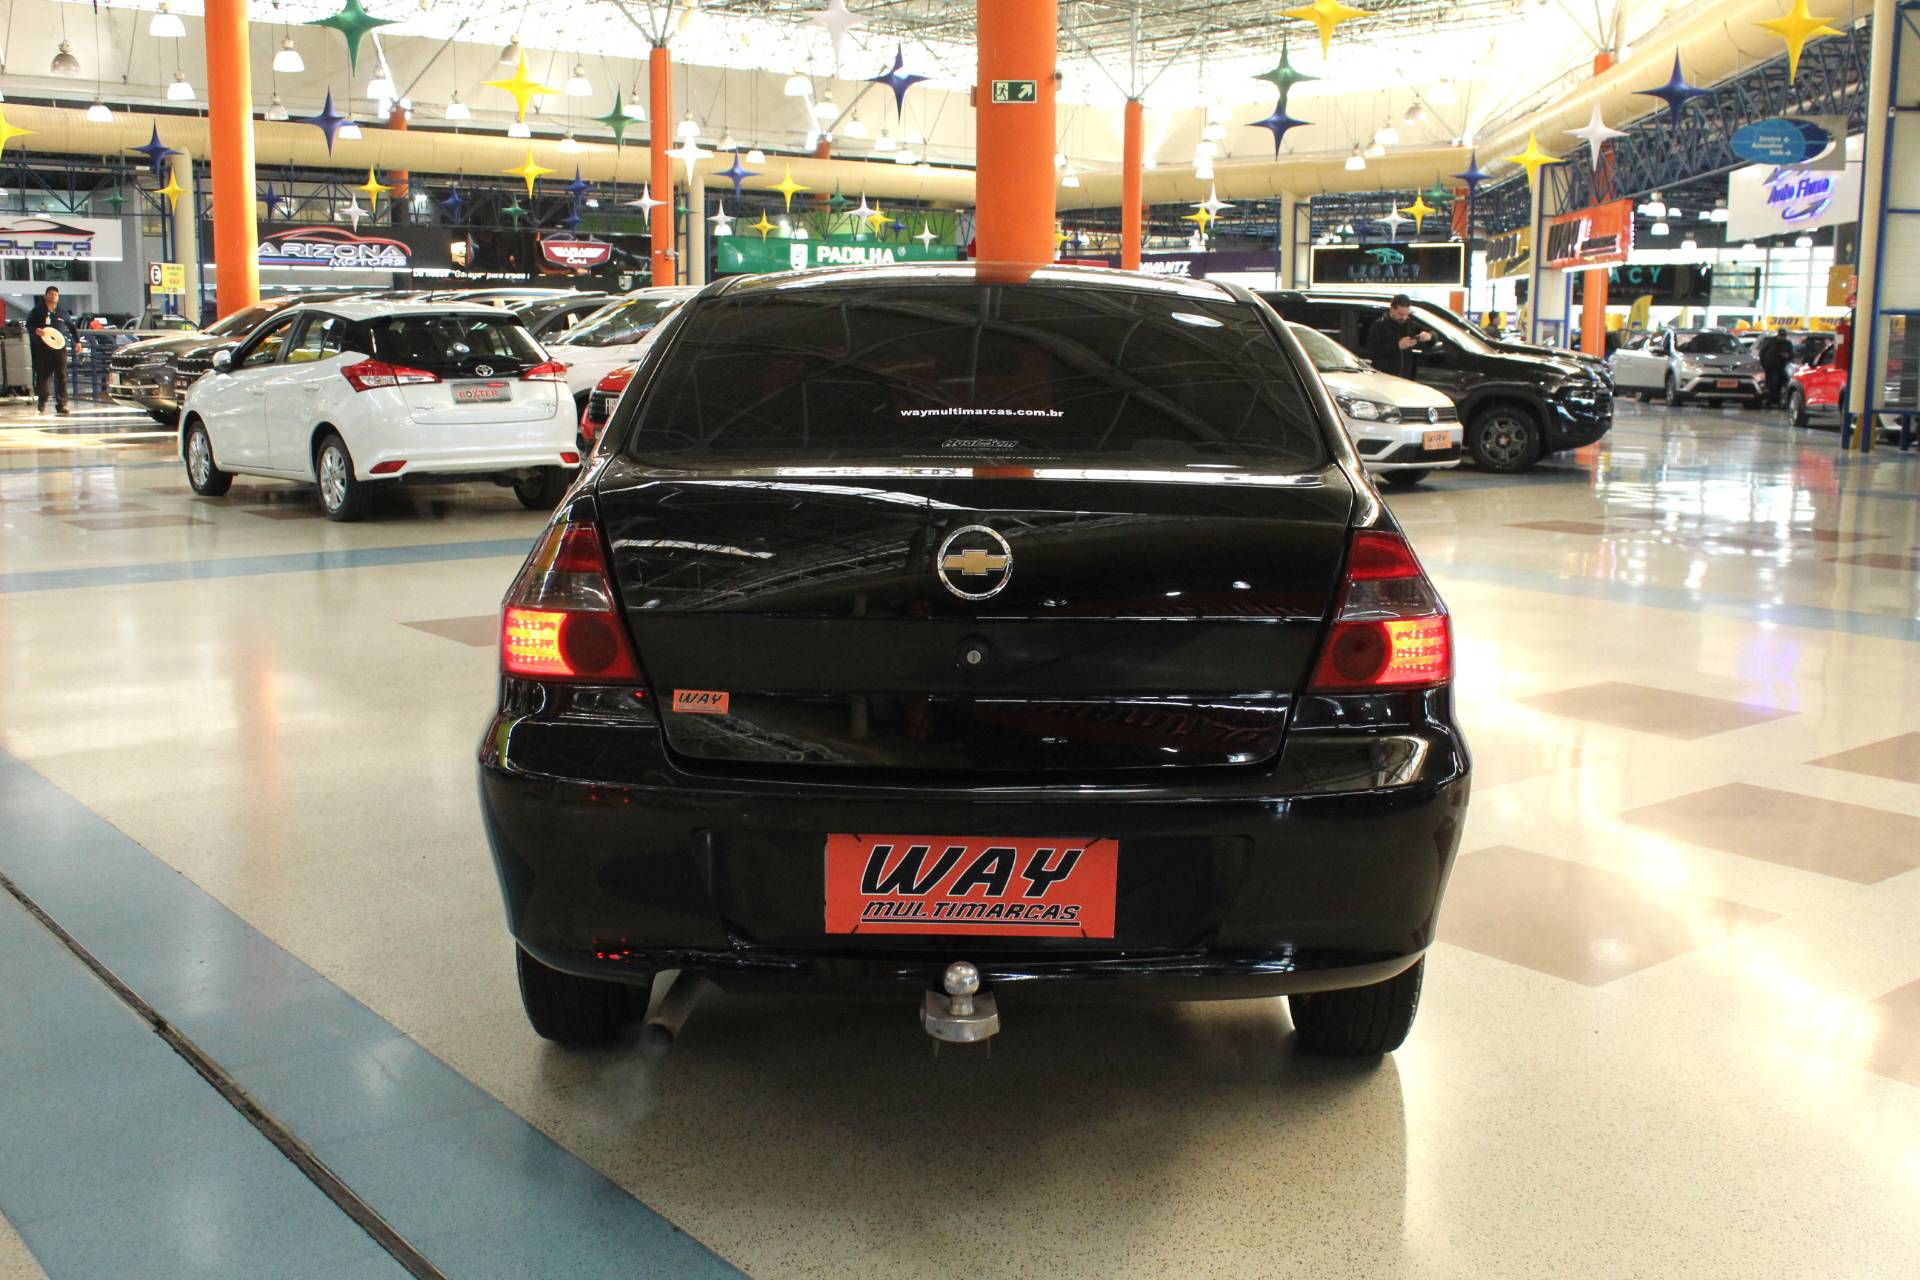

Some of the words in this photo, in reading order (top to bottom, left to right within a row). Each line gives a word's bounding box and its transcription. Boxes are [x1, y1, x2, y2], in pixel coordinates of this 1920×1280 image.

[258, 242, 407, 258] ARIZONA
[817, 245, 896, 264] PADILHA
[900, 407, 1065, 418] waymultimarcas.com.br
[679, 692, 723, 704] WAY
[860, 844, 1086, 899] WAY
[861, 900, 1082, 920] MULTIMARCAS
